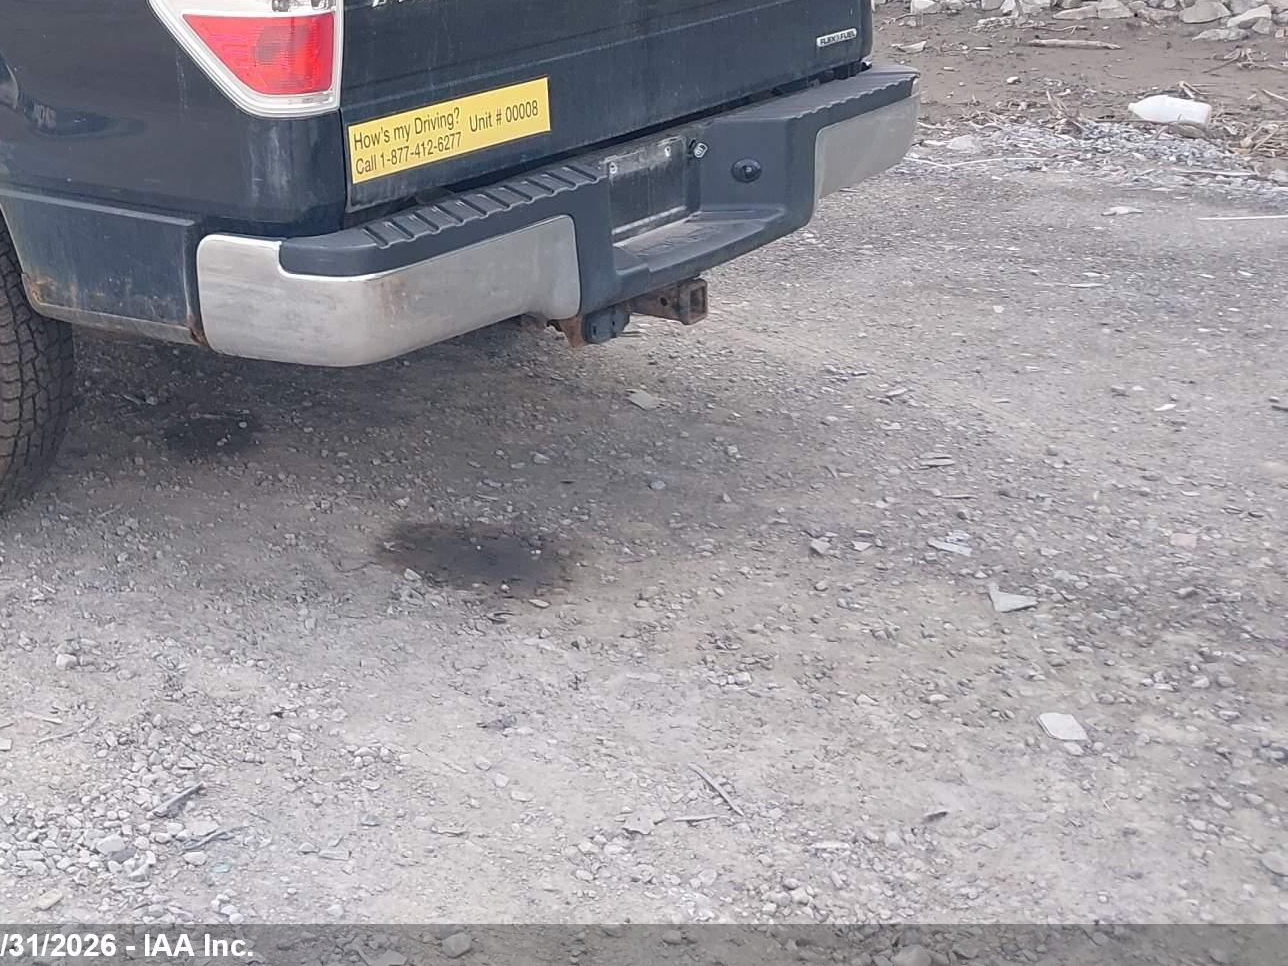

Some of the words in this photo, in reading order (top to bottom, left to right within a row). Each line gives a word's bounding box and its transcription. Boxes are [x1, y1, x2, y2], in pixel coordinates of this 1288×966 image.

[354, 126, 391, 151] How's
[393, 122, 411, 142] my
[414, 106, 461, 135] Driving?
[469, 115, 493, 133] Unit
[495, 108, 503, 127] #
[505, 99, 539, 123] 00008
[355, 153, 377, 175] Call
[379, 131, 462, 168] 1-877-412-6277
